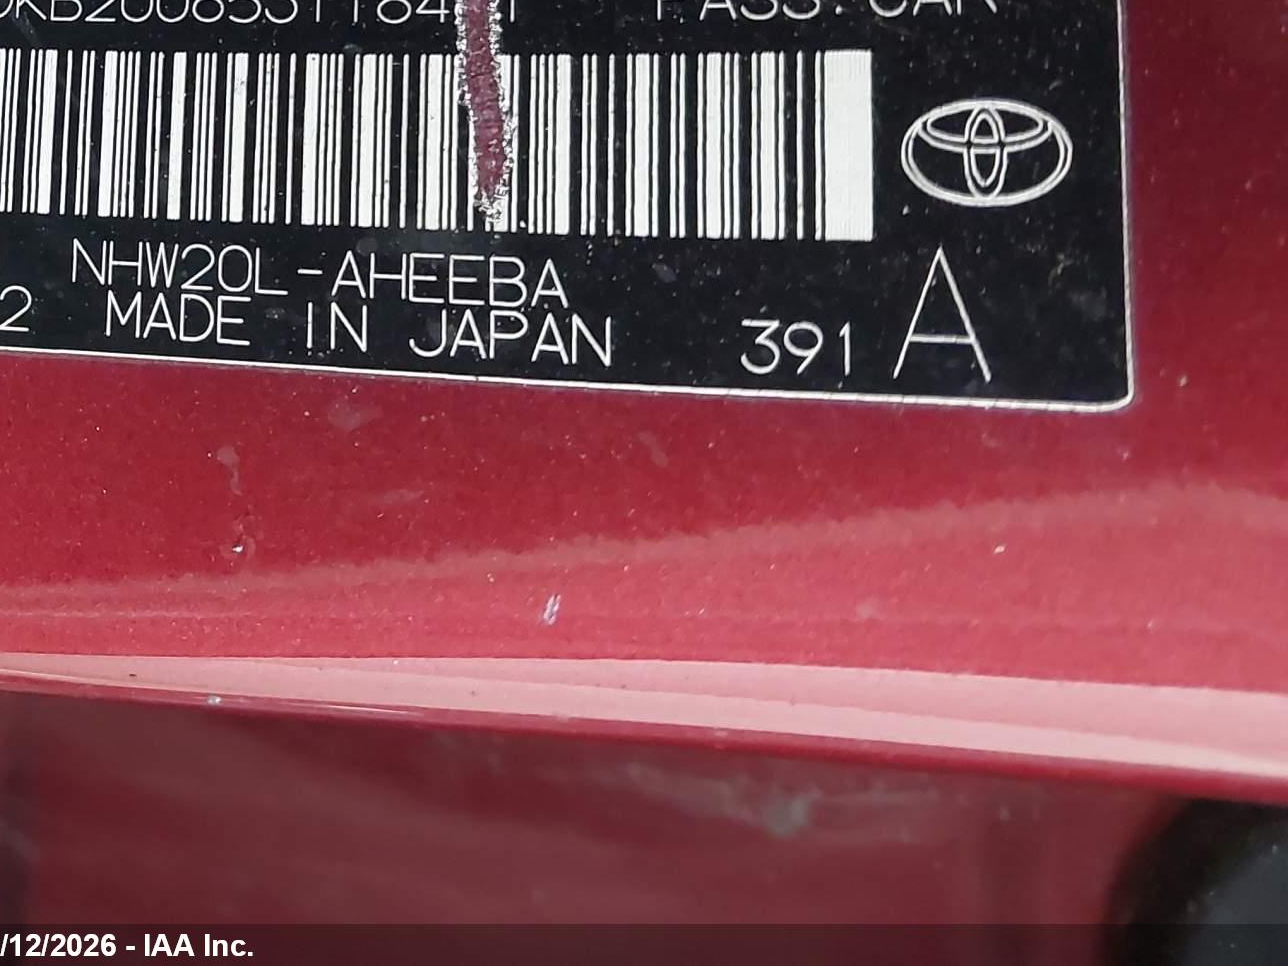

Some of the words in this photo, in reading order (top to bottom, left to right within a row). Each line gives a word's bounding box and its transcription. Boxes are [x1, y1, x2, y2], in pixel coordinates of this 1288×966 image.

[70, 236, 569, 310] NHW20L-AHEEBA
[892, 245, 993, 384] A
[103, 290, 252, 346] MADE
[305, 294, 369, 354] IN
[407, 311, 614, 369] JAPAN
[739, 317, 853, 377] 391
